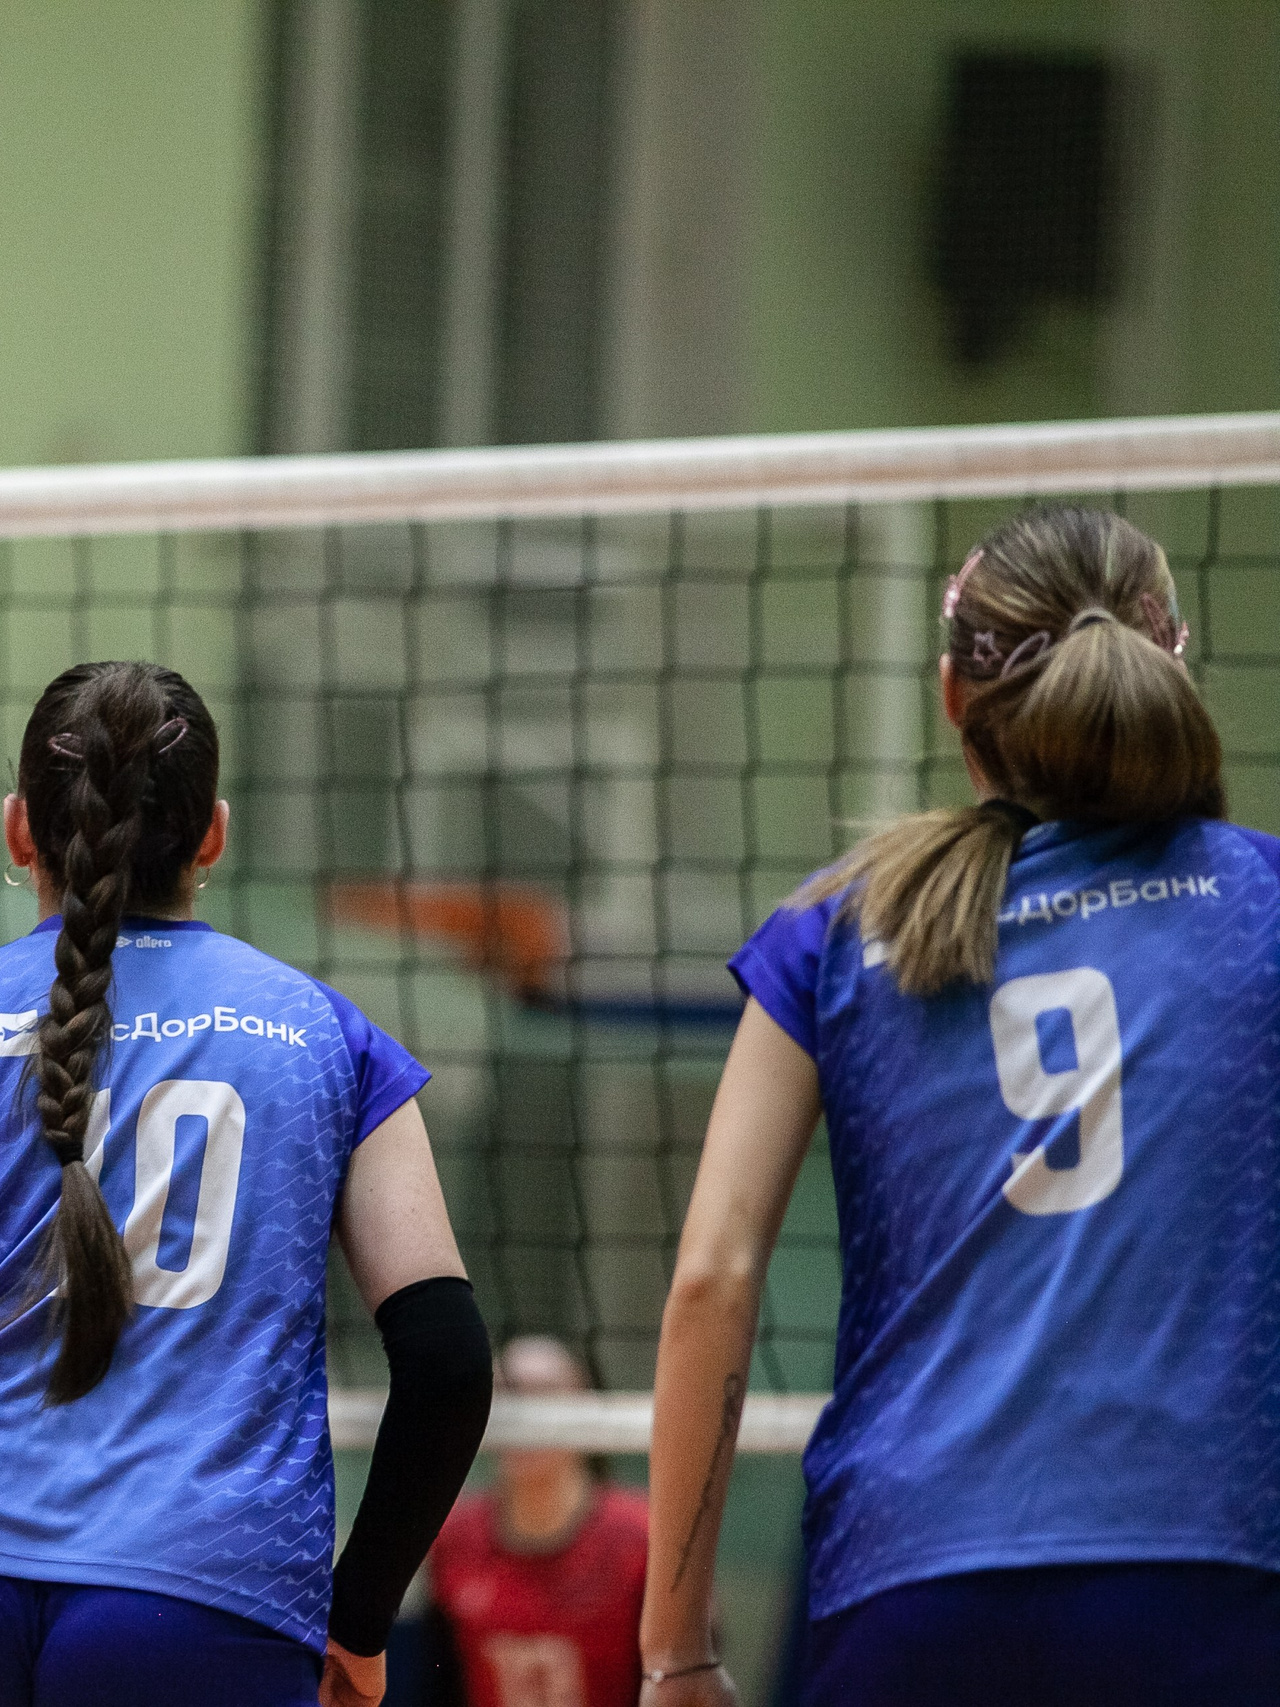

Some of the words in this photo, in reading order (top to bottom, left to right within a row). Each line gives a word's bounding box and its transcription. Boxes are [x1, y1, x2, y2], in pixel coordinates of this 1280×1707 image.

[997, 874, 1221, 926] ДорБанк
[109, 1005, 308, 1048] сДорБанк
[989, 966, 1124, 1217] 9
